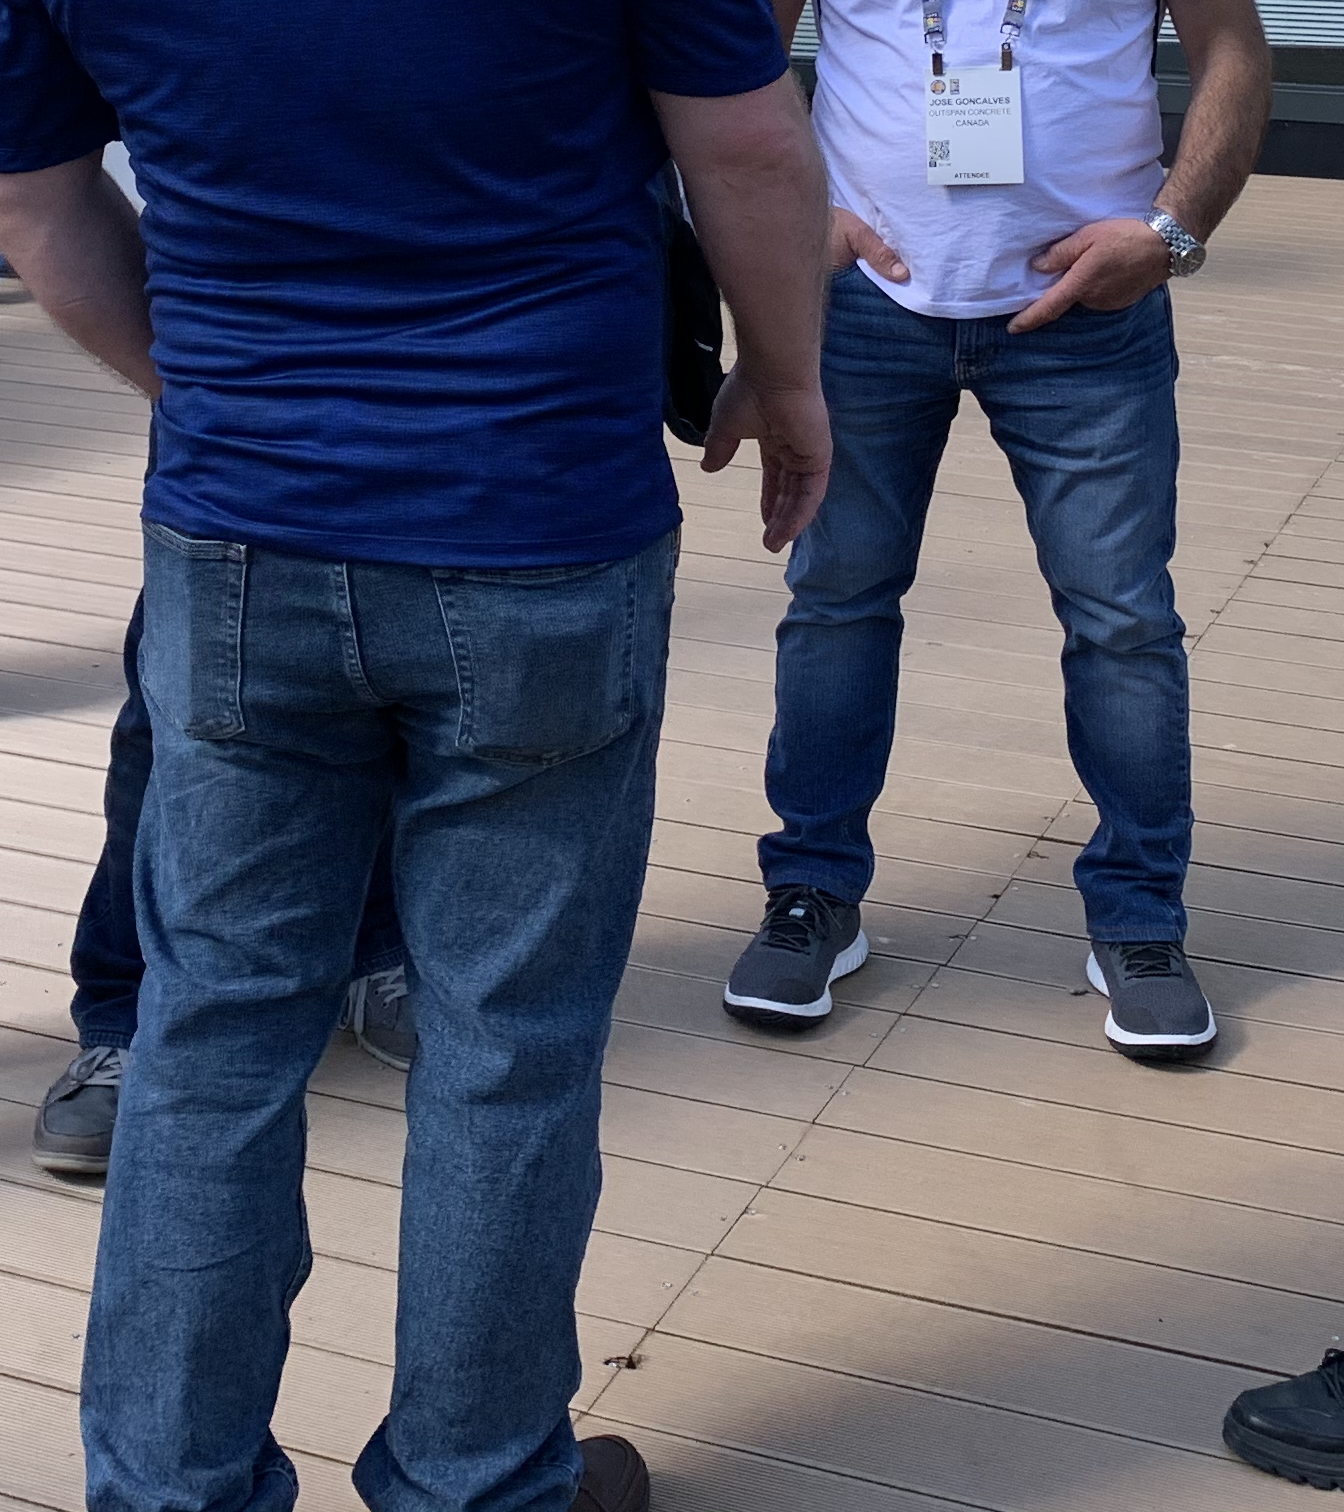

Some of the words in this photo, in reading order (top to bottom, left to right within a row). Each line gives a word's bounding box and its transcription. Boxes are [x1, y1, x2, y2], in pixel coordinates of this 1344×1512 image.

[929, 98, 953, 106] JOSE
[955, 96, 1011, 106] GONCALVES
[967, 107, 1012, 116] CONCRETE
